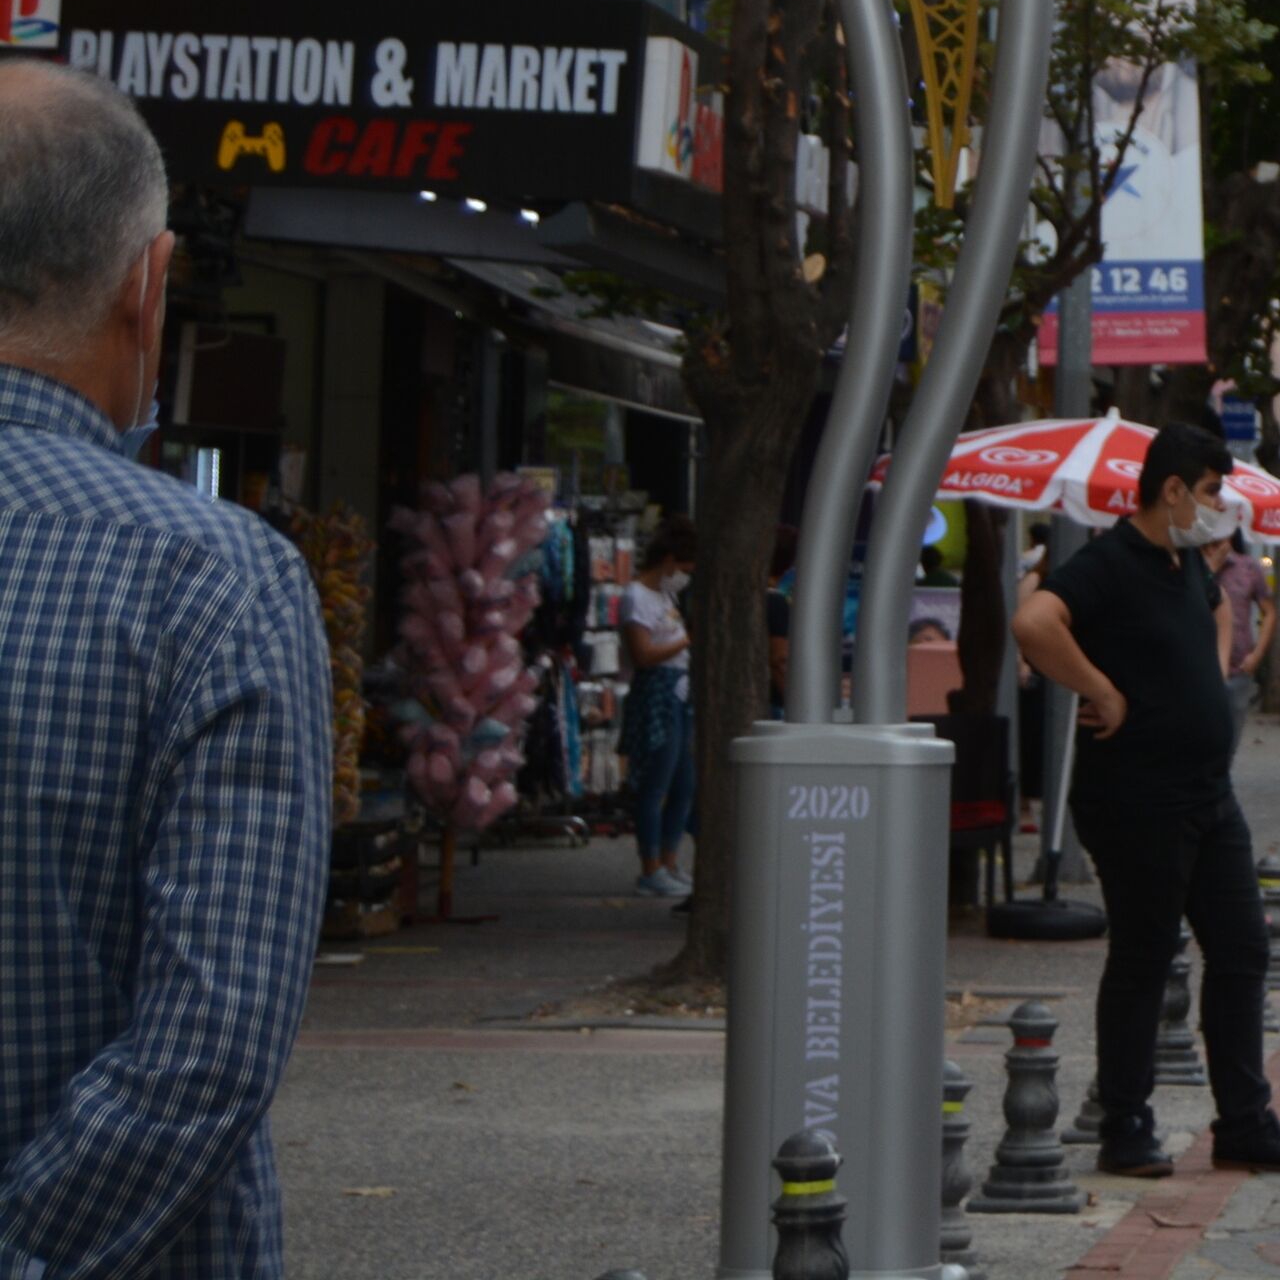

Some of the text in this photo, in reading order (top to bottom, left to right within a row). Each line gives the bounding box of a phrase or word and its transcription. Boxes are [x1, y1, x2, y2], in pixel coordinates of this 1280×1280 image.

[69, 28, 628, 114] PLAYSTATION & MARKET
[304, 116, 474, 182] CAFE
[1109, 267, 1142, 293] 12
[1148, 267, 1189, 293] 46
[942, 470, 1025, 495] ALGIDA
[787, 785, 870, 820] 2020
[801, 831, 847, 1061] BELEDİYESİ
